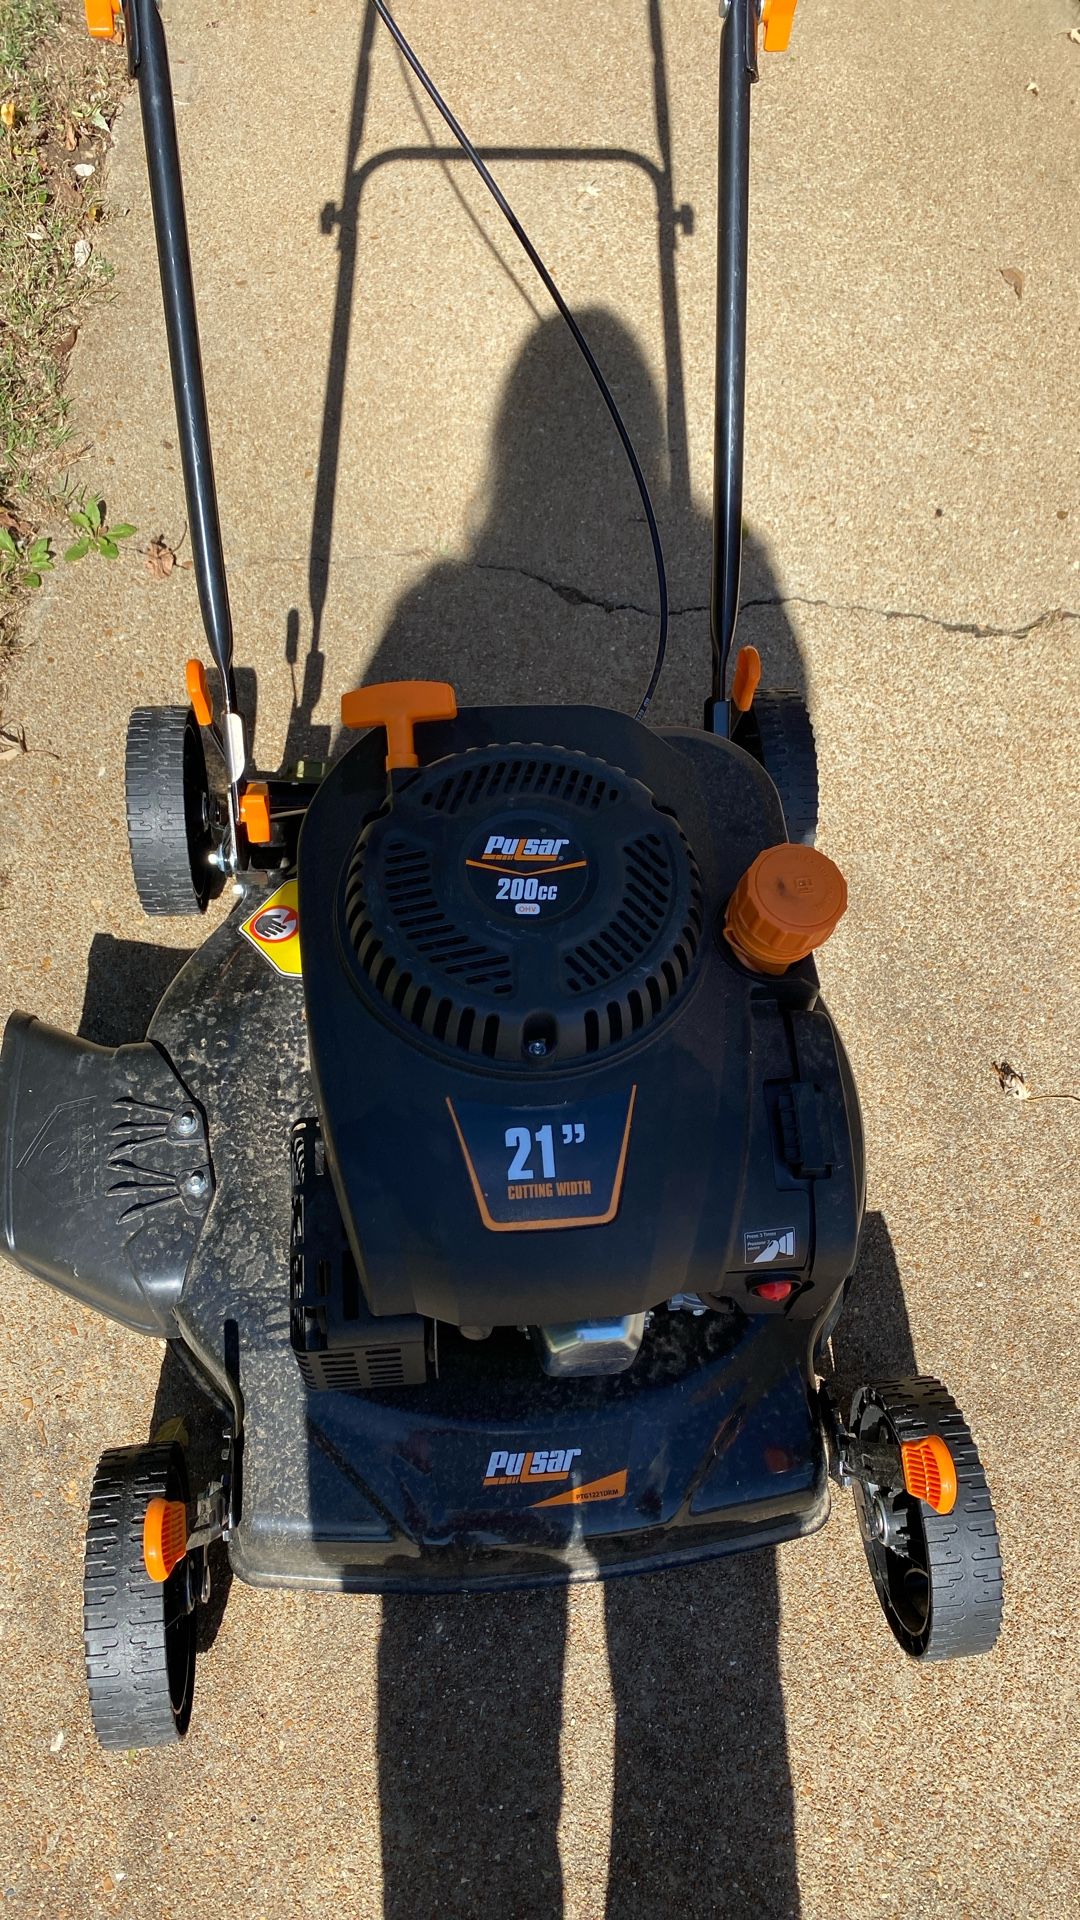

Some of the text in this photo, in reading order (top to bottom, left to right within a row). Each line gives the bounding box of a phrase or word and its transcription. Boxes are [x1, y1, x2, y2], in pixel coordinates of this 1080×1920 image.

[496, 878, 558, 900] 200cc
[518, 904, 537, 913] OHV
[507, 1180, 592, 1200] CUTTING WIDTH
